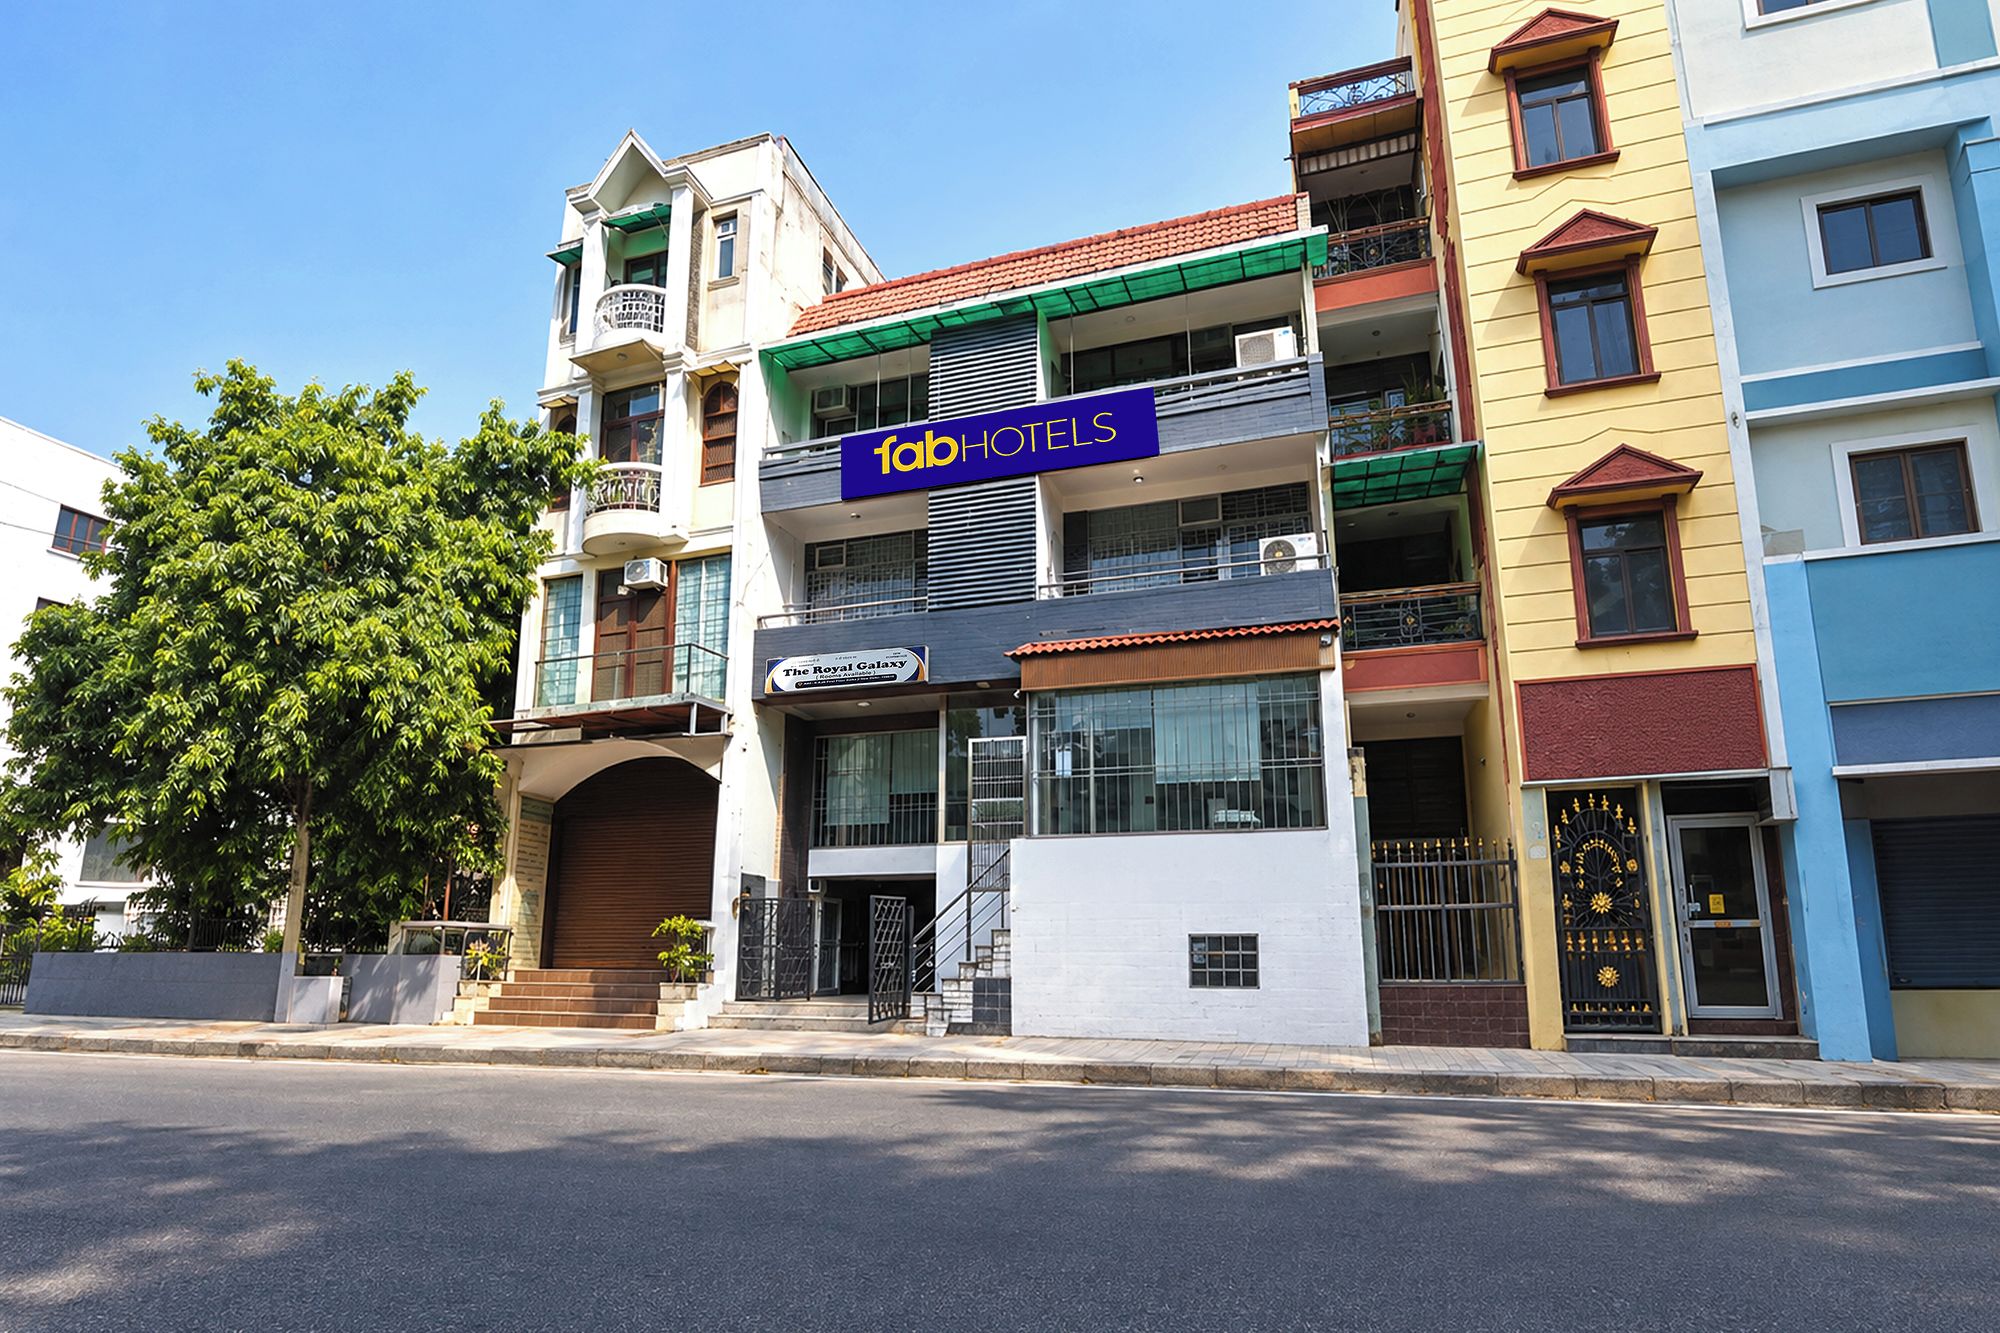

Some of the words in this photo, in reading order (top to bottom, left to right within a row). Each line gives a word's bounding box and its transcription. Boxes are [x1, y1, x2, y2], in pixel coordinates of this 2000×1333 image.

[874, 412, 1117, 474] fabHOTELS
[783, 668, 809, 677] The
[812, 663, 853, 674] Royal
[856, 660, 907, 670] Galaxy
